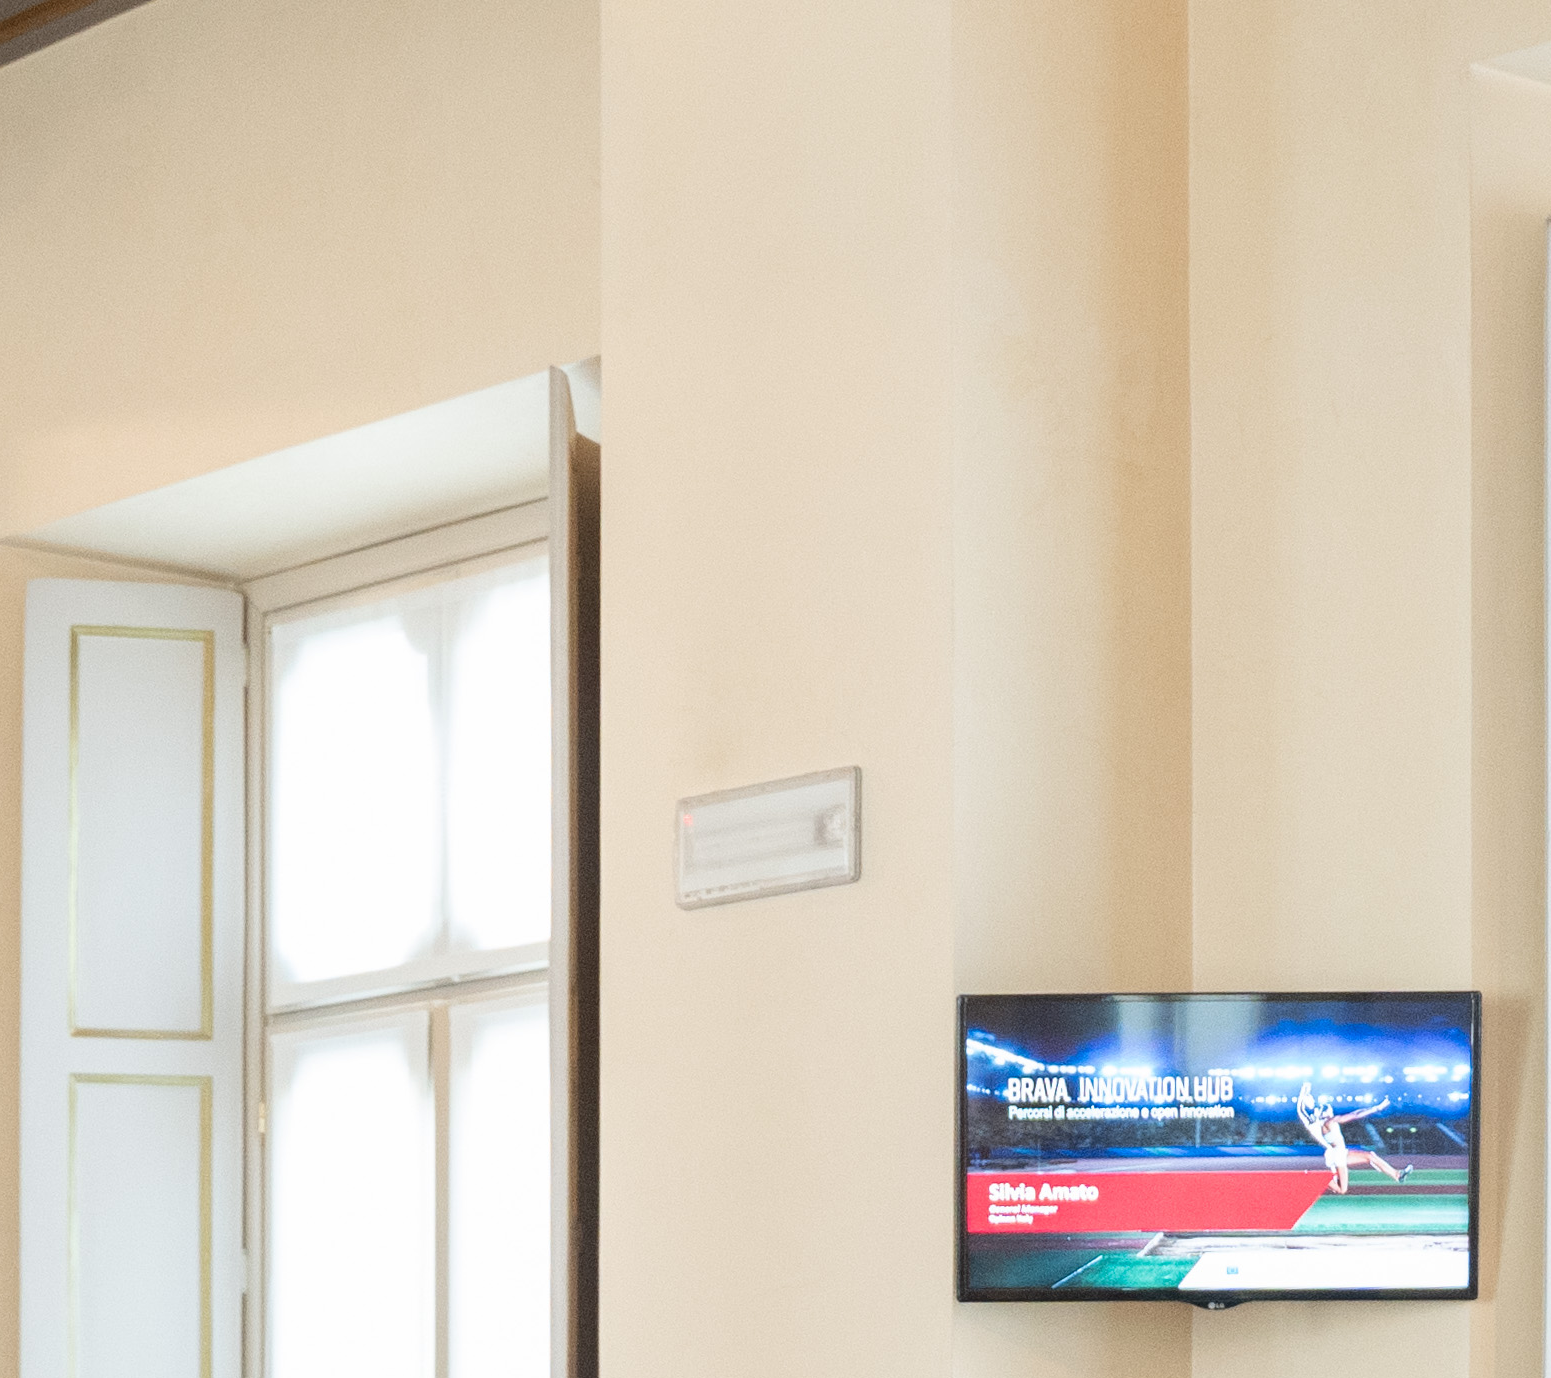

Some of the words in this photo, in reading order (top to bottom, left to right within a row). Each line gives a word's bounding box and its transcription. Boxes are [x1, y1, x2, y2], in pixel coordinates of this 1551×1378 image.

[1008, 1077, 1071, 1102] BRAVA
[1077, 1076, 1193, 1103] INNOVATION
[1194, 1076, 1233, 1102] HUB
[1008, 1105, 1052, 1121] Percorsi
[1054, 1105, 1065, 1119] di
[1066, 1105, 1140, 1119] accelerazione
[1141, 1107, 1149, 1118] e
[1151, 1107, 1178, 1121] open
[1180, 1104, 1234, 1118] innovation
[989, 1183, 1036, 1201] Silvia
[1038, 1184, 1099, 1201] Amato
